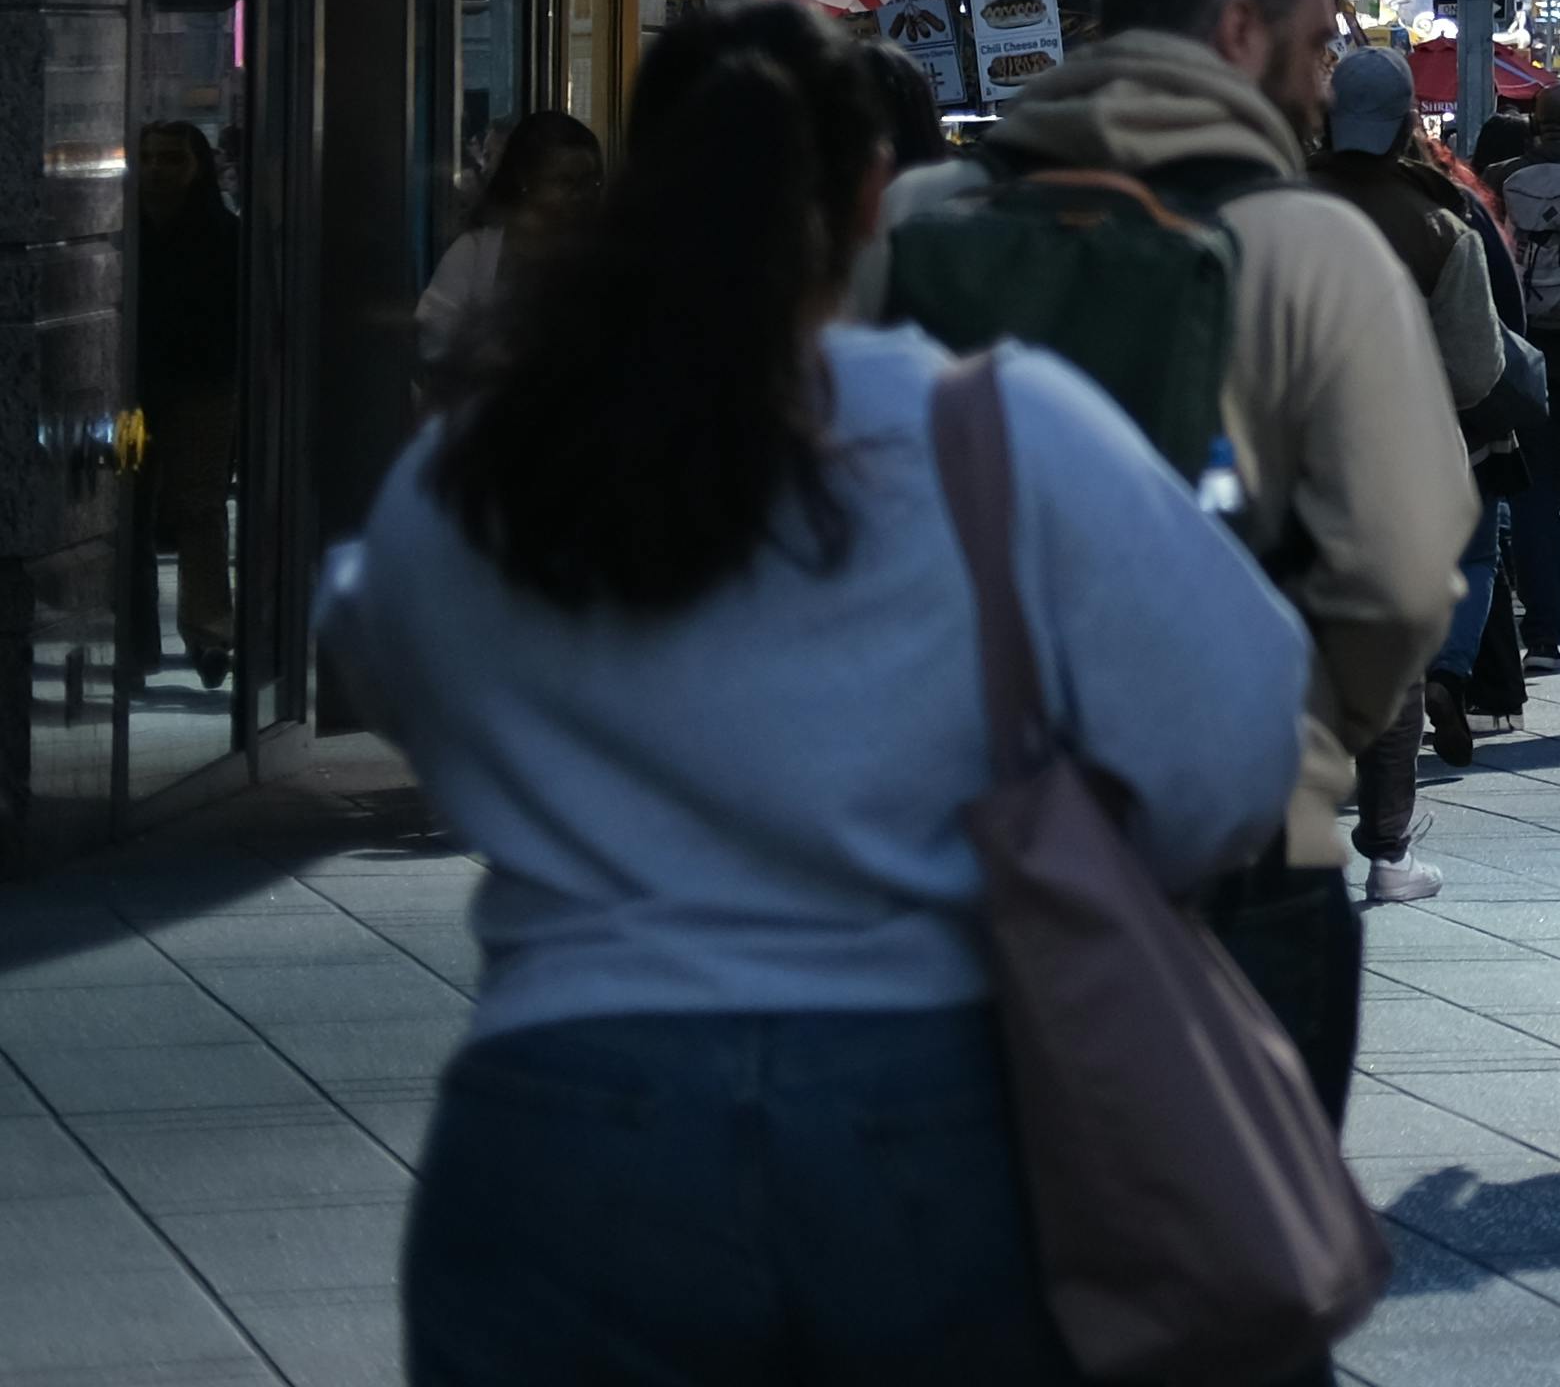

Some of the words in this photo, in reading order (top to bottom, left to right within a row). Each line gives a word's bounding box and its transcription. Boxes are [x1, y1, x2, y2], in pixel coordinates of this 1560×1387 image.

[980, 43, 1001, 55] Chili
[1003, 40, 1038, 53] Cheese
[1039, 38, 1058, 51] Dog
